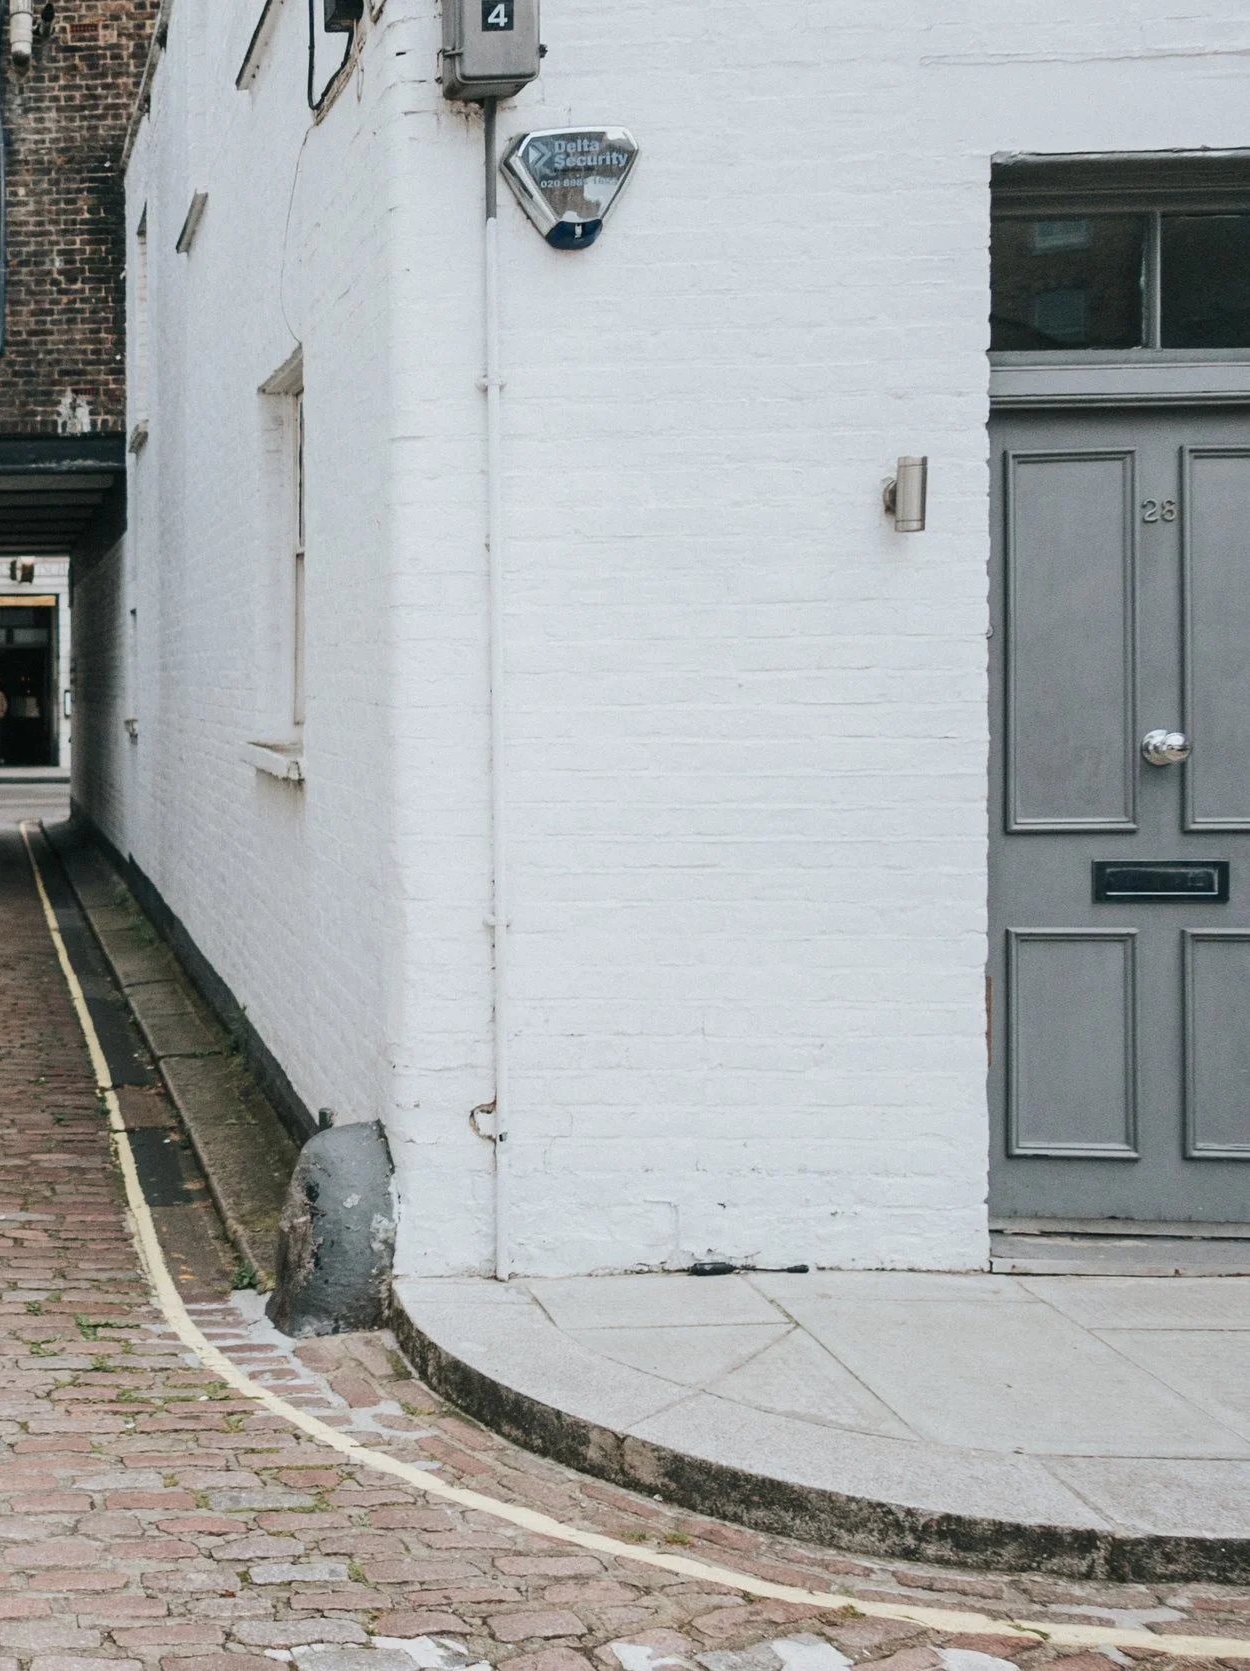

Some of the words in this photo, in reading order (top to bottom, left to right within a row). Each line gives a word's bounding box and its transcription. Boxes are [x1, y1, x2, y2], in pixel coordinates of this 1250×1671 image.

[487, 3, 508, 27] 4
[554, 139, 599, 153] Delta
[554, 151, 628, 168] Security
[541, 179, 560, 188] 020
